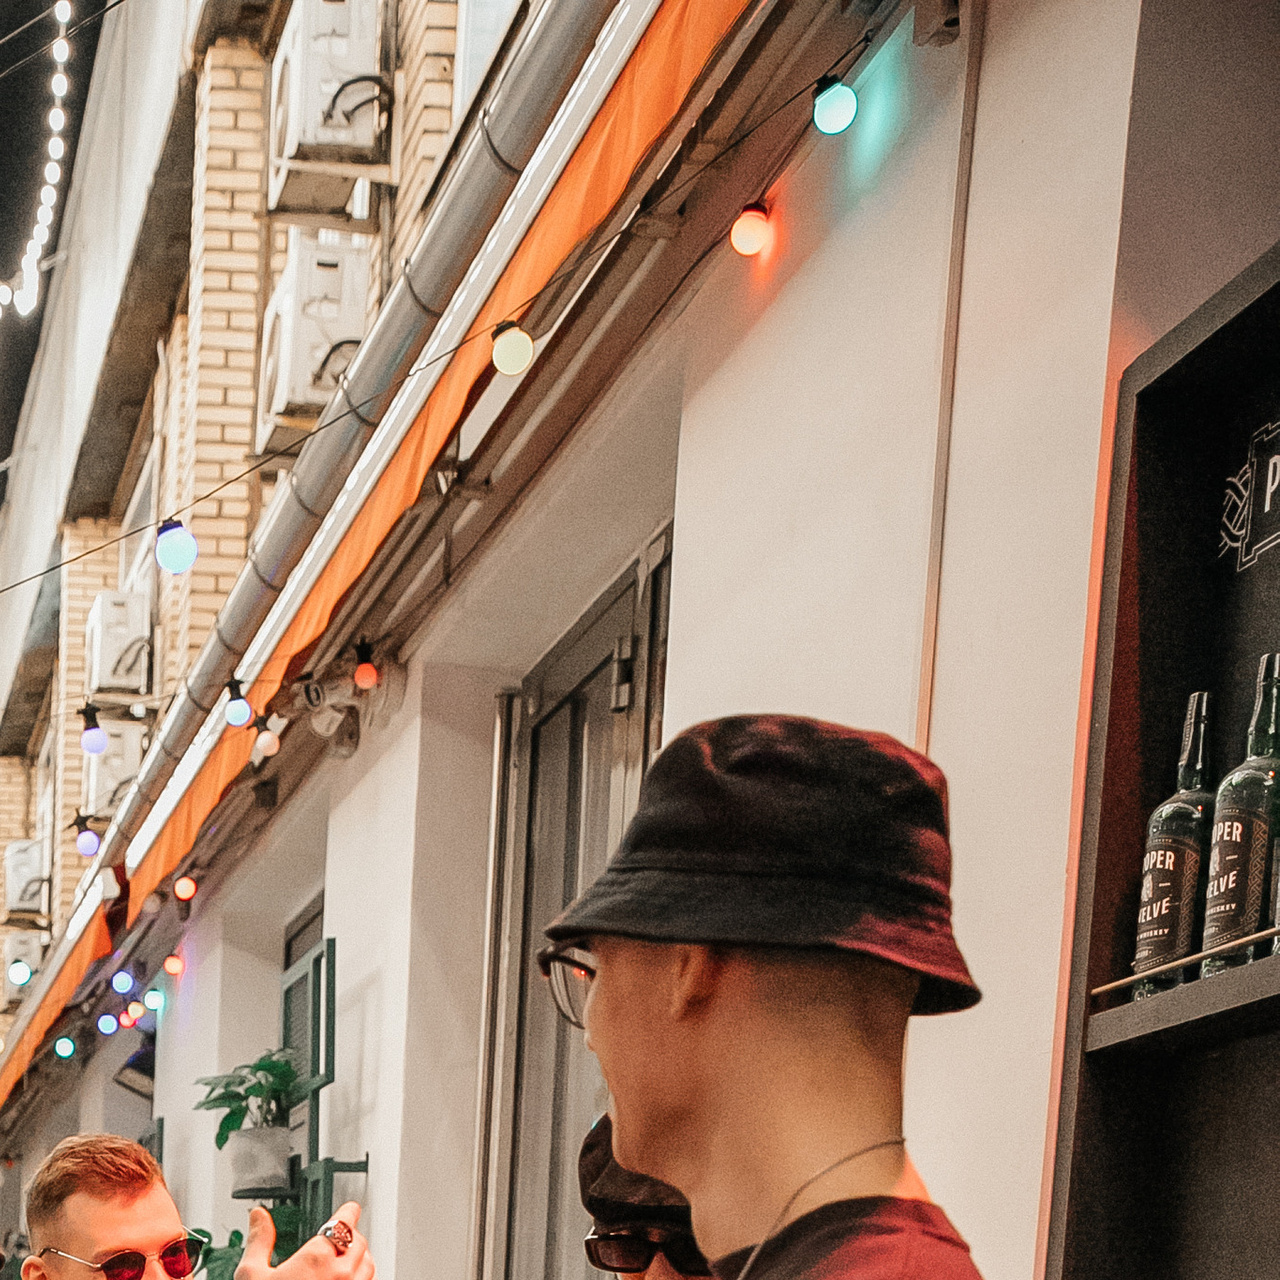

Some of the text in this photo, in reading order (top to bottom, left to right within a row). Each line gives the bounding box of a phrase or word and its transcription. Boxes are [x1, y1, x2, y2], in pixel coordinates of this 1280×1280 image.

[1142, 850, 1175, 874] OPER
[1206, 870, 1238, 898] ELVE
[1138, 897, 1171, 923] ELVE
